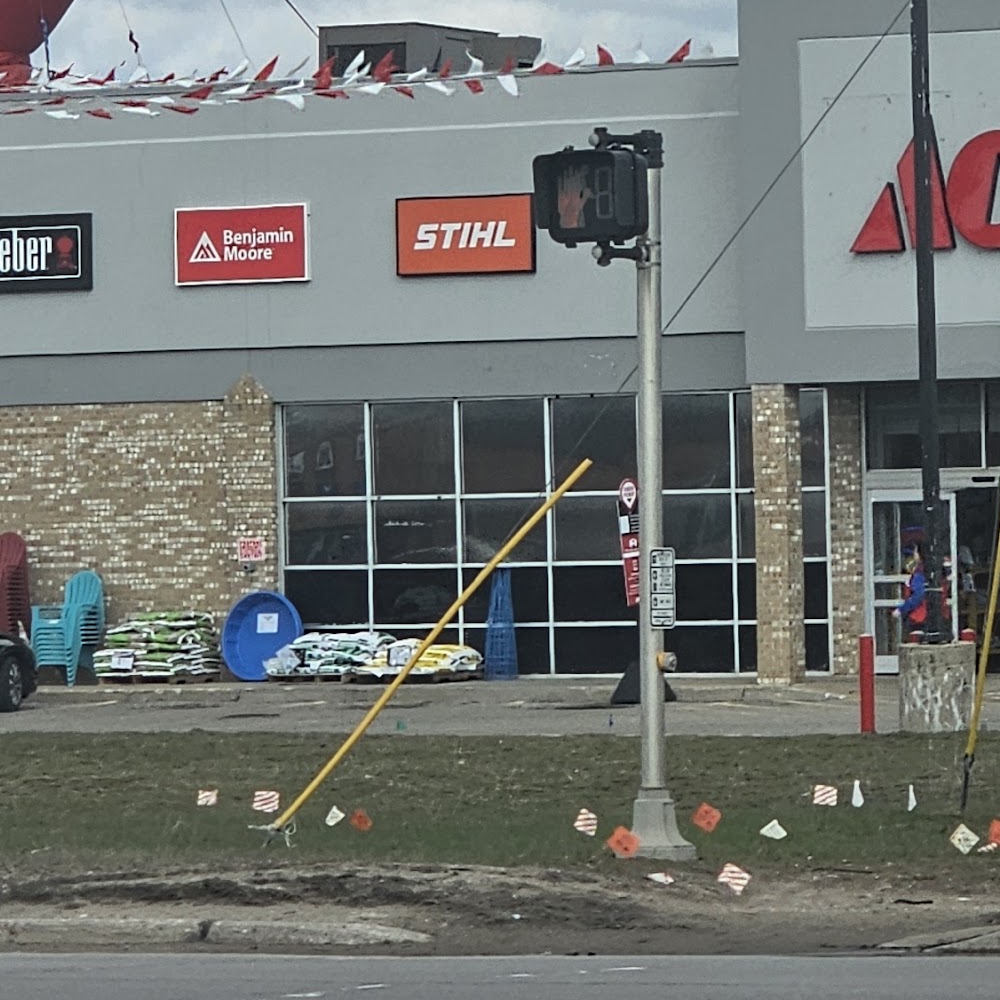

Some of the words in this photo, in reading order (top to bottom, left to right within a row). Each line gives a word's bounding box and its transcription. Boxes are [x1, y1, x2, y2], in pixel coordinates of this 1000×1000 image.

[223, 227, 294, 247] Benjamin
[414, 221, 516, 250] STIHL
[0, 230, 52, 272] eber
[223, 246, 273, 261] Moore
